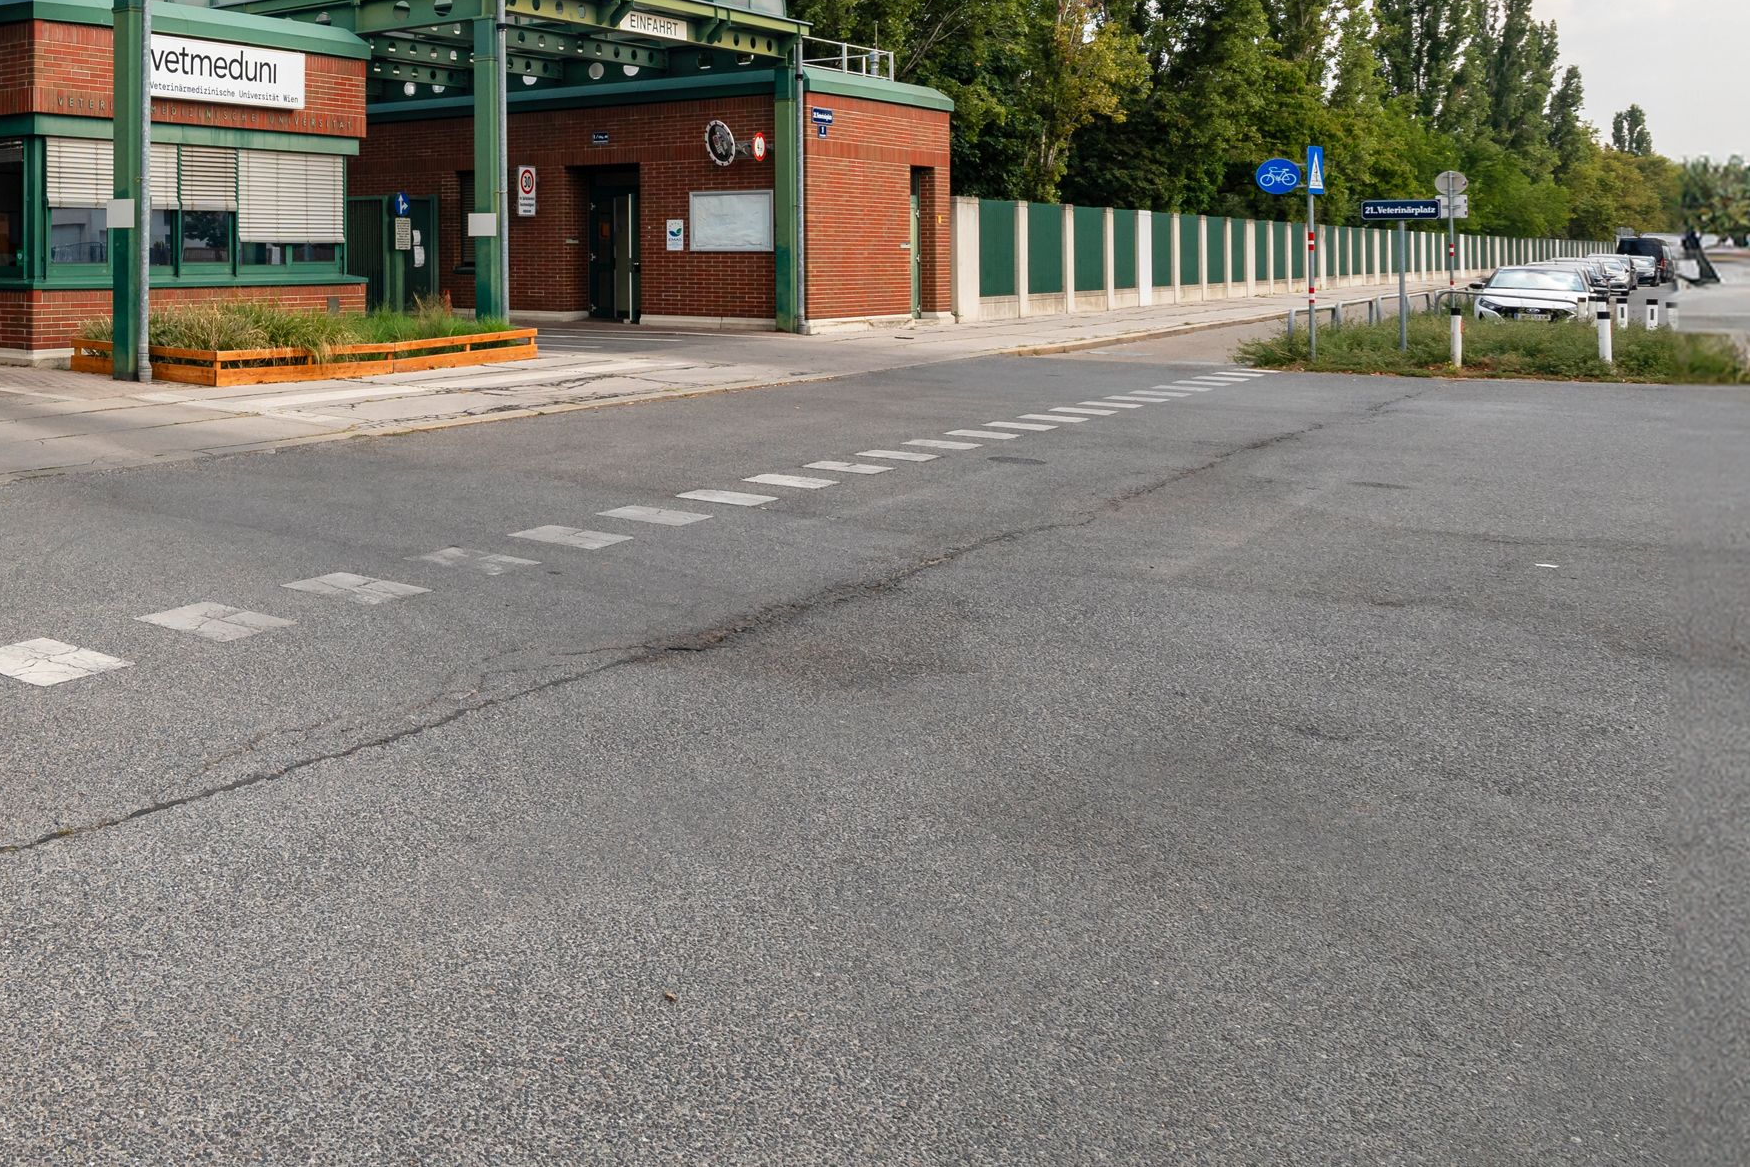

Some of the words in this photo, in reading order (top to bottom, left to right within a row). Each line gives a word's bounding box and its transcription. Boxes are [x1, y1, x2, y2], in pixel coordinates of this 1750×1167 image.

[630, 14, 679, 36] EINFAHRT
[150, 46, 277, 84] vetmeduni
[150, 81, 236, 98] Veterinärmedizinische
[238, 89, 280, 103] Universität
[282, 94, 299, 104] Wien
[523, 175, 531, 188] 30
[1377, 205, 1436, 216] Veterinärplatz
